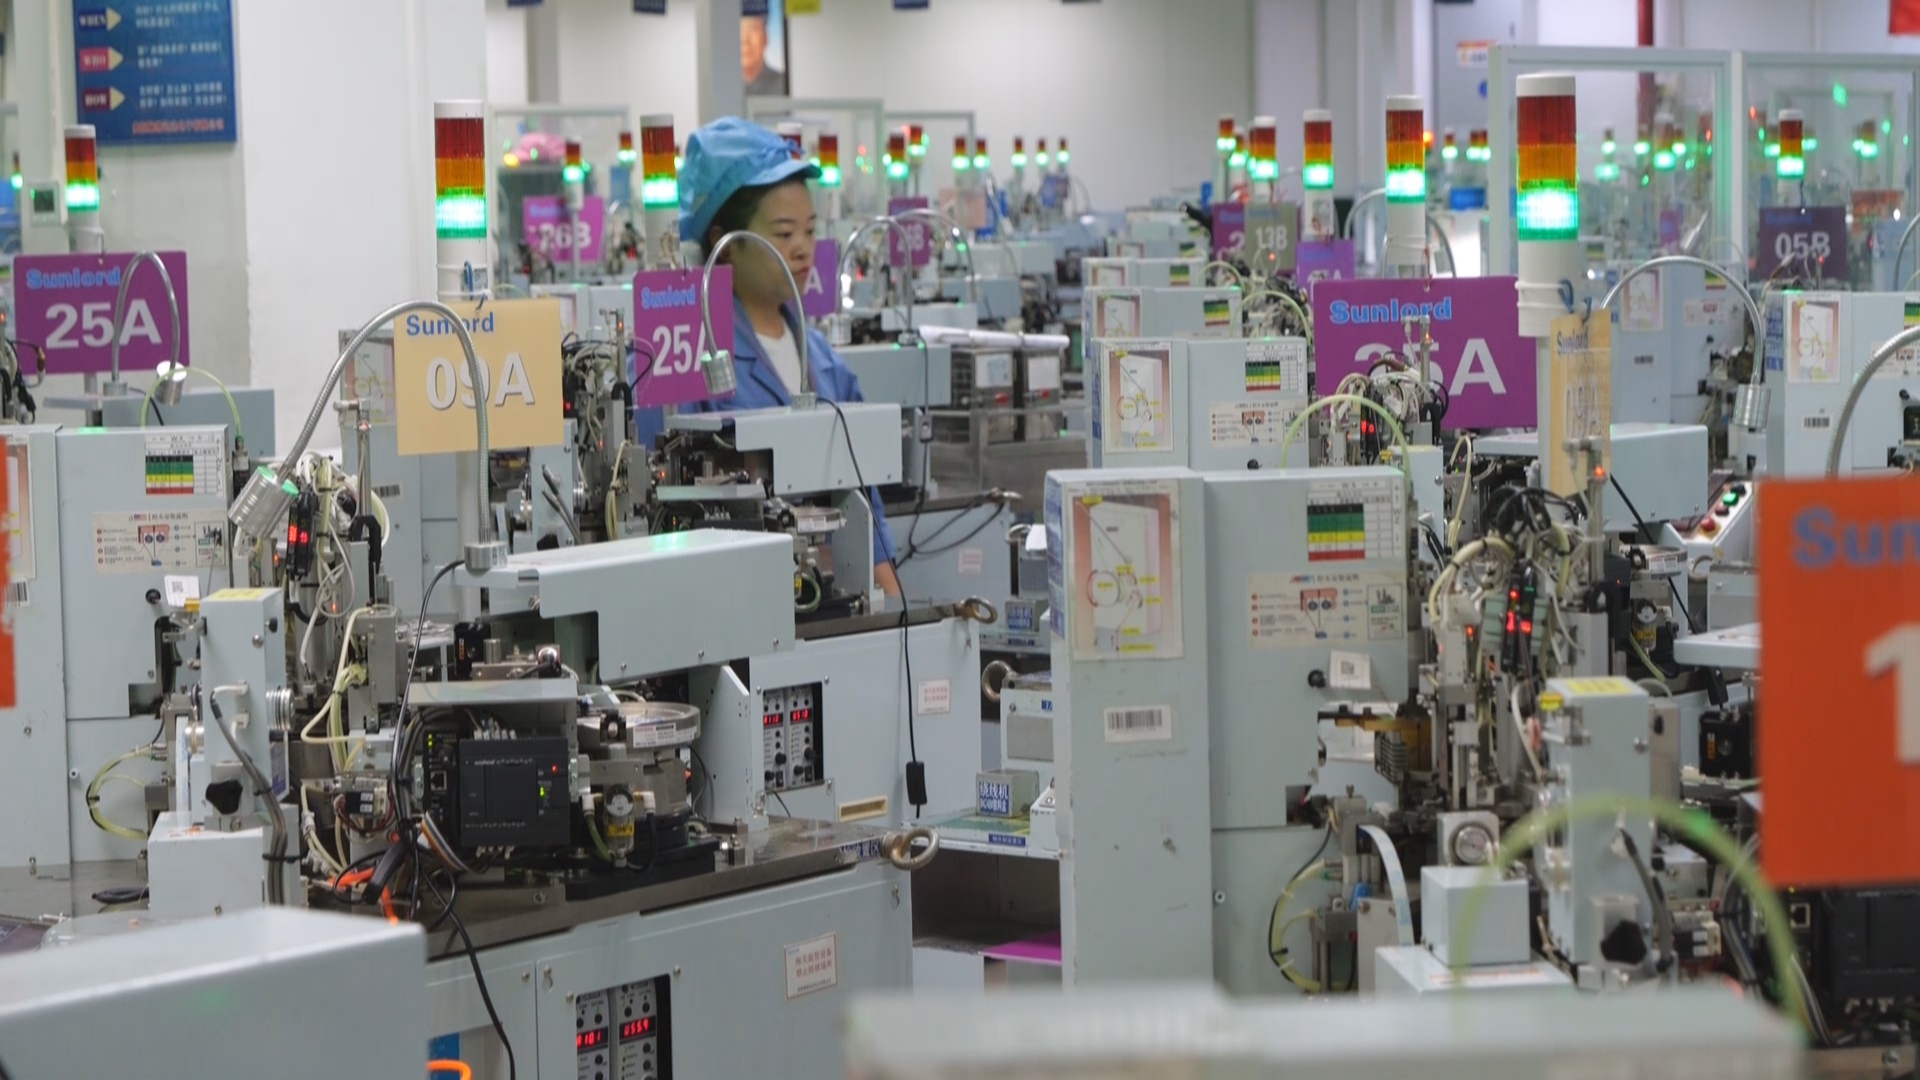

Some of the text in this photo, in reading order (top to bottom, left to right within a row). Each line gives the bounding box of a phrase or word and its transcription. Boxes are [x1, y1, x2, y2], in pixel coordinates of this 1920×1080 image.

[85, 93, 107, 107] HOW
[1256, 225, 1287, 250] 13B
[1775, 231, 1831, 260] 05B
[26, 267, 121, 289] Sunlord
[641, 284, 696, 309] Sunlord
[1330, 296, 1452, 324] Sunlord
[46, 298, 162, 349] 25A
[407, 312, 494, 336] Sunord
[426, 352, 535, 411] 09A
[979, 780, 1009, 800] 绕线机
